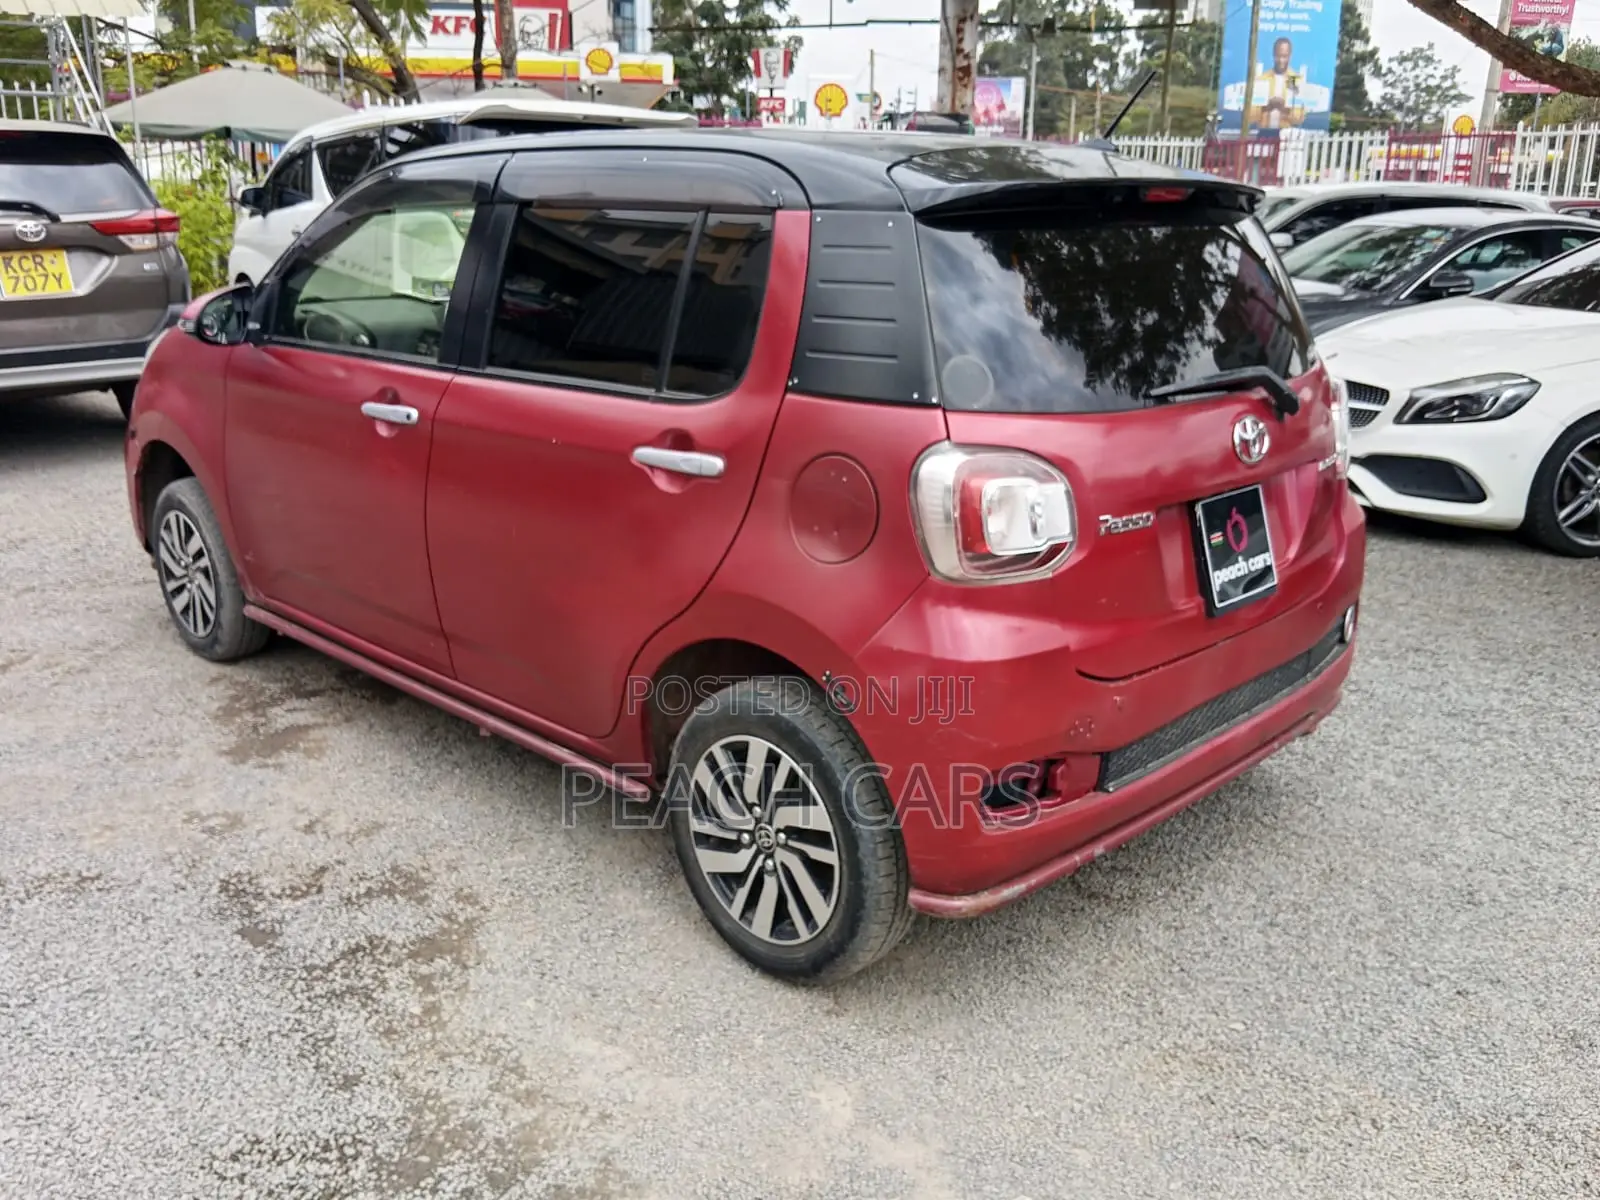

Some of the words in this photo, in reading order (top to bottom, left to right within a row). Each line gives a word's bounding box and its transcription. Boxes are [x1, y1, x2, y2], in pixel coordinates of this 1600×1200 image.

[1518, 3, 1569, 16] Trustworthy!
[760, 99, 784, 110] KFC
[2, 253, 46, 274] KCR
[7, 273, 63, 293] 707Y
[1213, 555, 1248, 592] peach
[1248, 552, 1272, 572] cars
